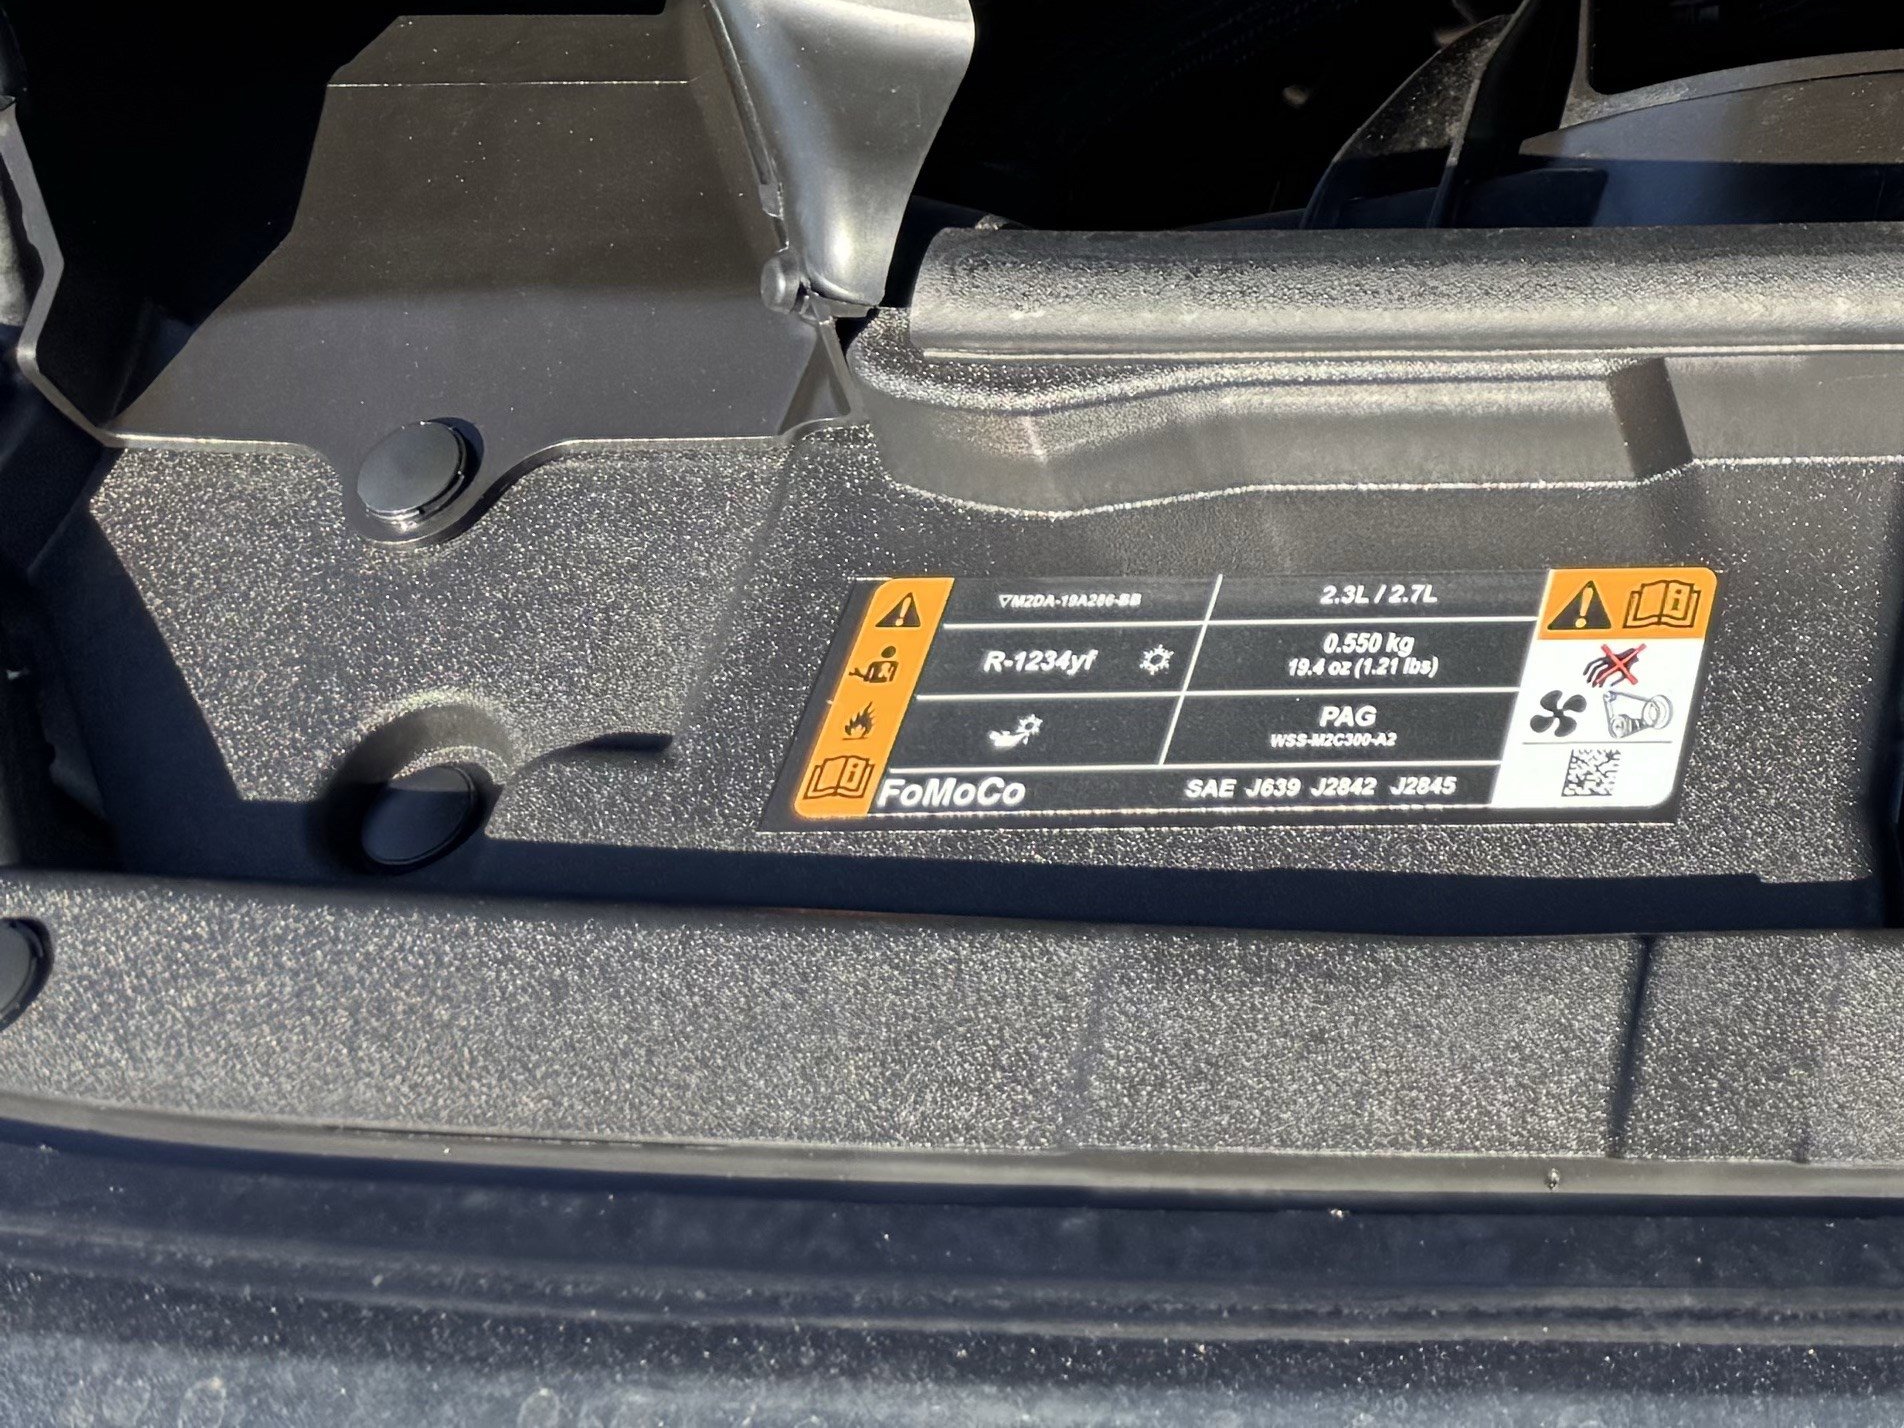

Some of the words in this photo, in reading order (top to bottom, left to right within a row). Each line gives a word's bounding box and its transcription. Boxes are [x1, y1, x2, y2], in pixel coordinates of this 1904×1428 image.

[1320, 584, 1369, 605] 2.3L
[1374, 584, 1386, 604] /
[1389, 584, 1438, 605] 2.7L
[1323, 632, 1383, 654] 0.550
[1386, 632, 1415, 658] kg
[983, 648, 1098, 676] R-1234yf
[1288, 657, 1326, 676] 19.4
[1328, 660, 1352, 676] oz
[1353, 656, 1398, 679] (1.21
[1403, 656, 1439, 679] lbs)
[1319, 705, 1377, 727] PAG
[877, 776, 1026, 808] FoMoCo
[1184, 778, 1237, 798] SAE
[1245, 777, 1301, 796] J639
[1310, 776, 1377, 796] J2842
[1390, 776, 1457, 795] J2845
